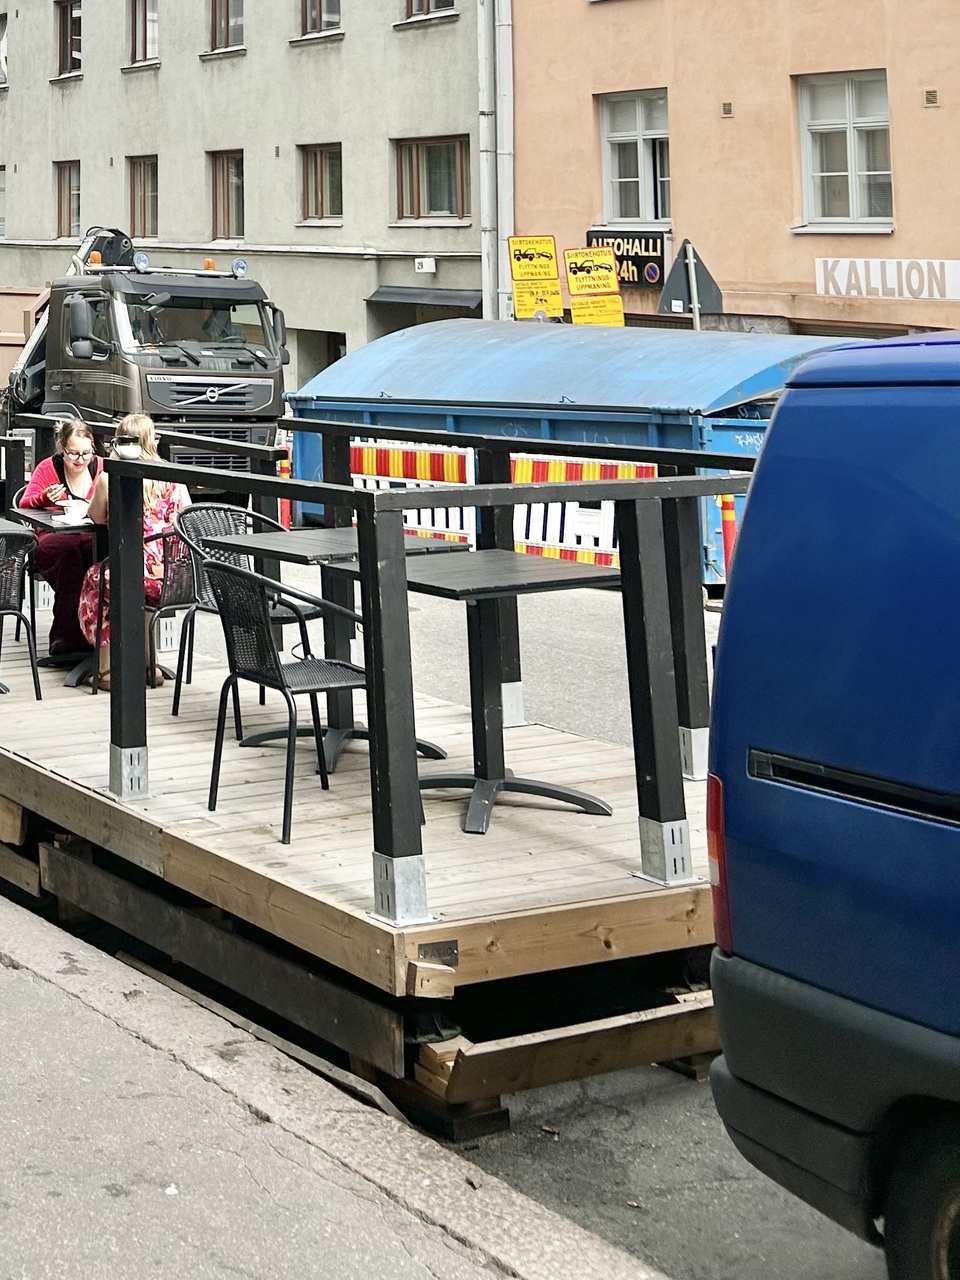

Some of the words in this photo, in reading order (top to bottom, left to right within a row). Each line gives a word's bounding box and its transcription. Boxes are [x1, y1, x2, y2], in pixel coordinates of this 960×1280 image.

[566, 249, 612, 259] SIIRTOKEHOTUS
[417, 261, 424, 270] 29
[822, 259, 947, 299] KALLION
